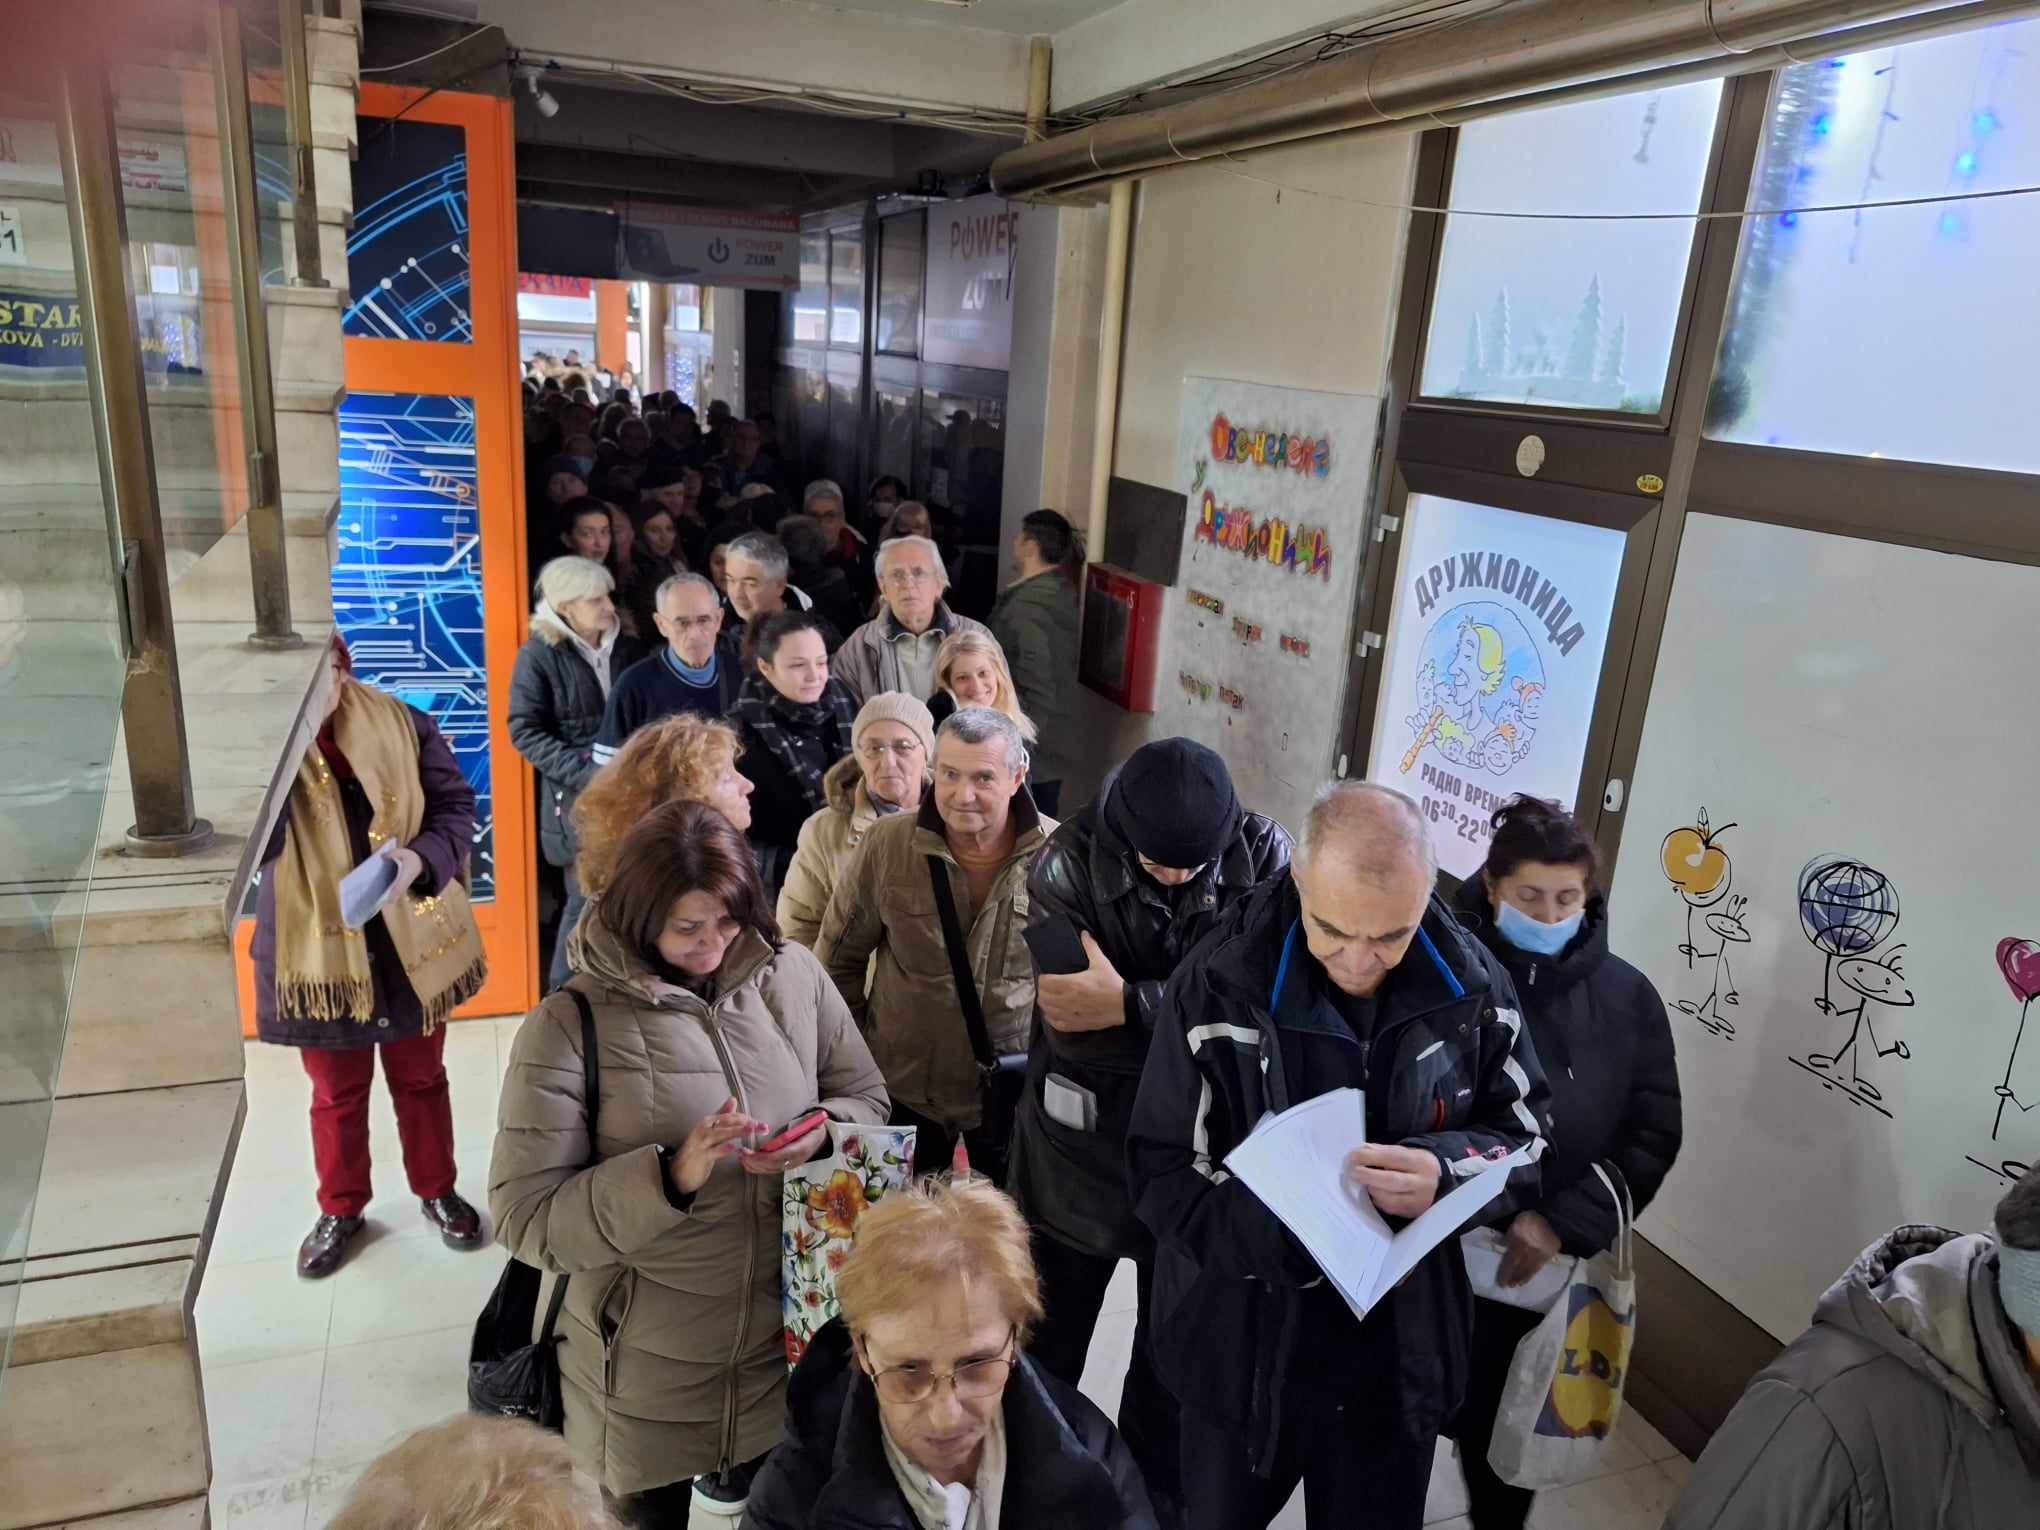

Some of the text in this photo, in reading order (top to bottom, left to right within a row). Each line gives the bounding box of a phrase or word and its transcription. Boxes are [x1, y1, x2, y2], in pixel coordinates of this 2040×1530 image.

[745, 253, 776, 266] ZUM
[1414, 551, 1586, 657] ДРУЖИОНИЦА
[1420, 763, 1463, 798] РАДНО
